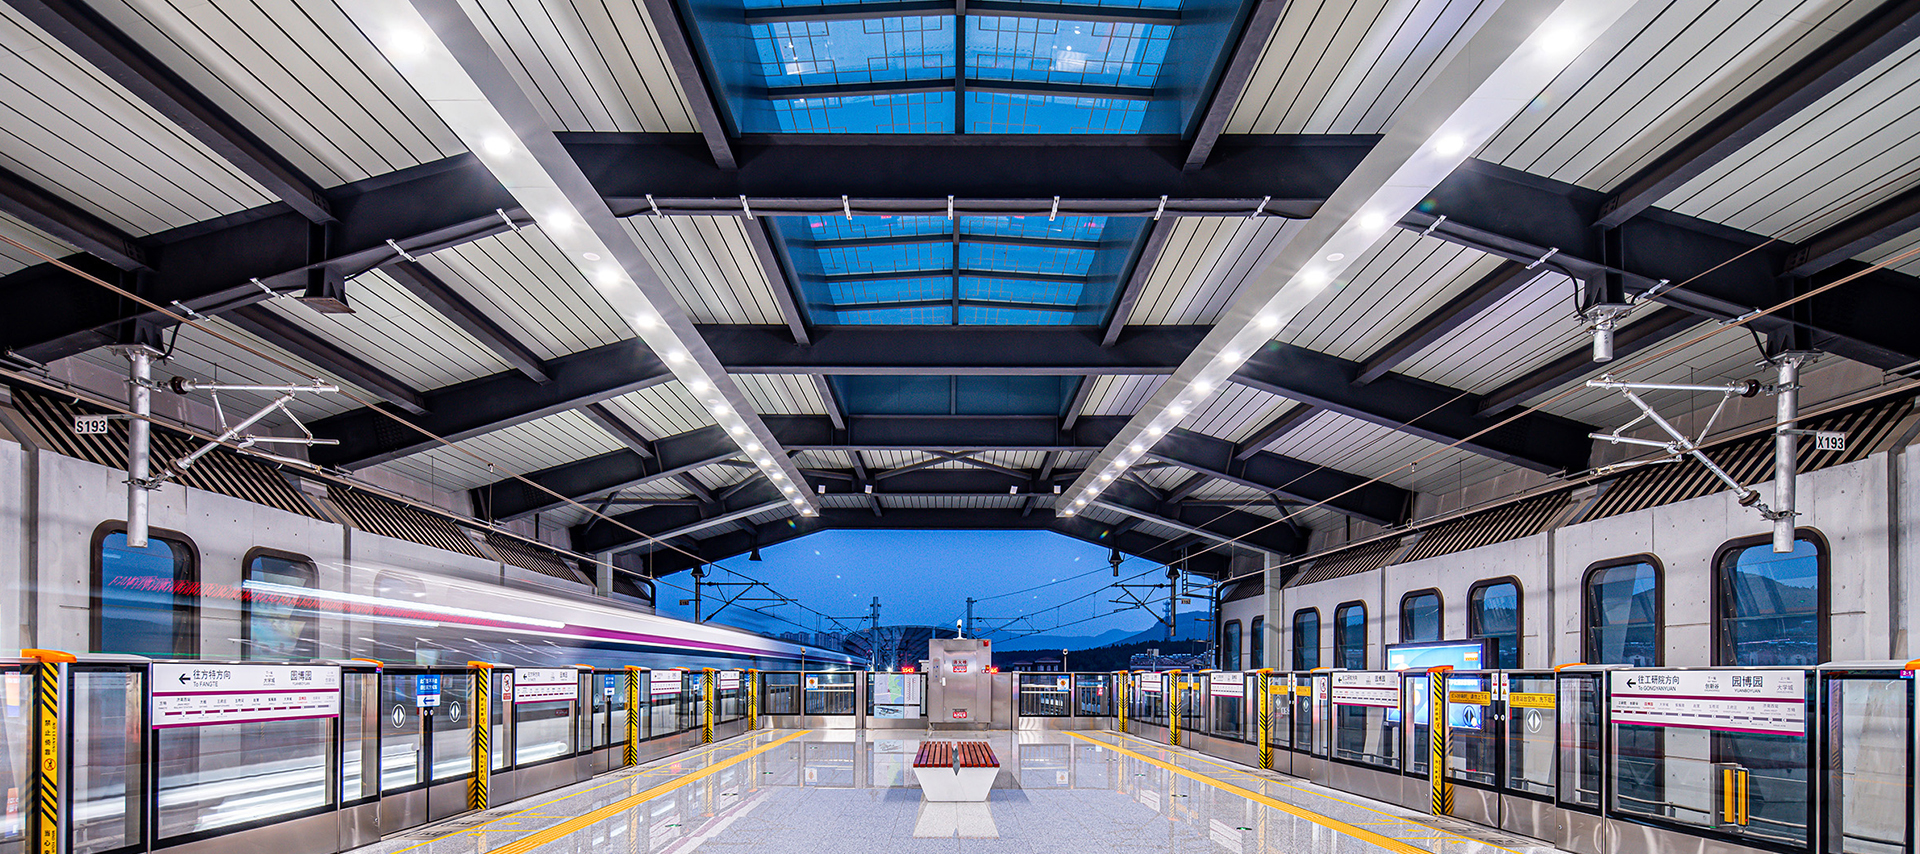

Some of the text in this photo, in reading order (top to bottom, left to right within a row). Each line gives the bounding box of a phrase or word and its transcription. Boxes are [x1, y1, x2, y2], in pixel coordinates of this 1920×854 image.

[76, 420, 106, 433] S193
[1817, 436, 1844, 449] X193
[193, 669, 231, 680] 往方特方向
[290, 670, 312, 681] 园博园
[1638, 675, 1680, 685] 往工研院方向
[1732, 675, 1763, 688] 园博园
